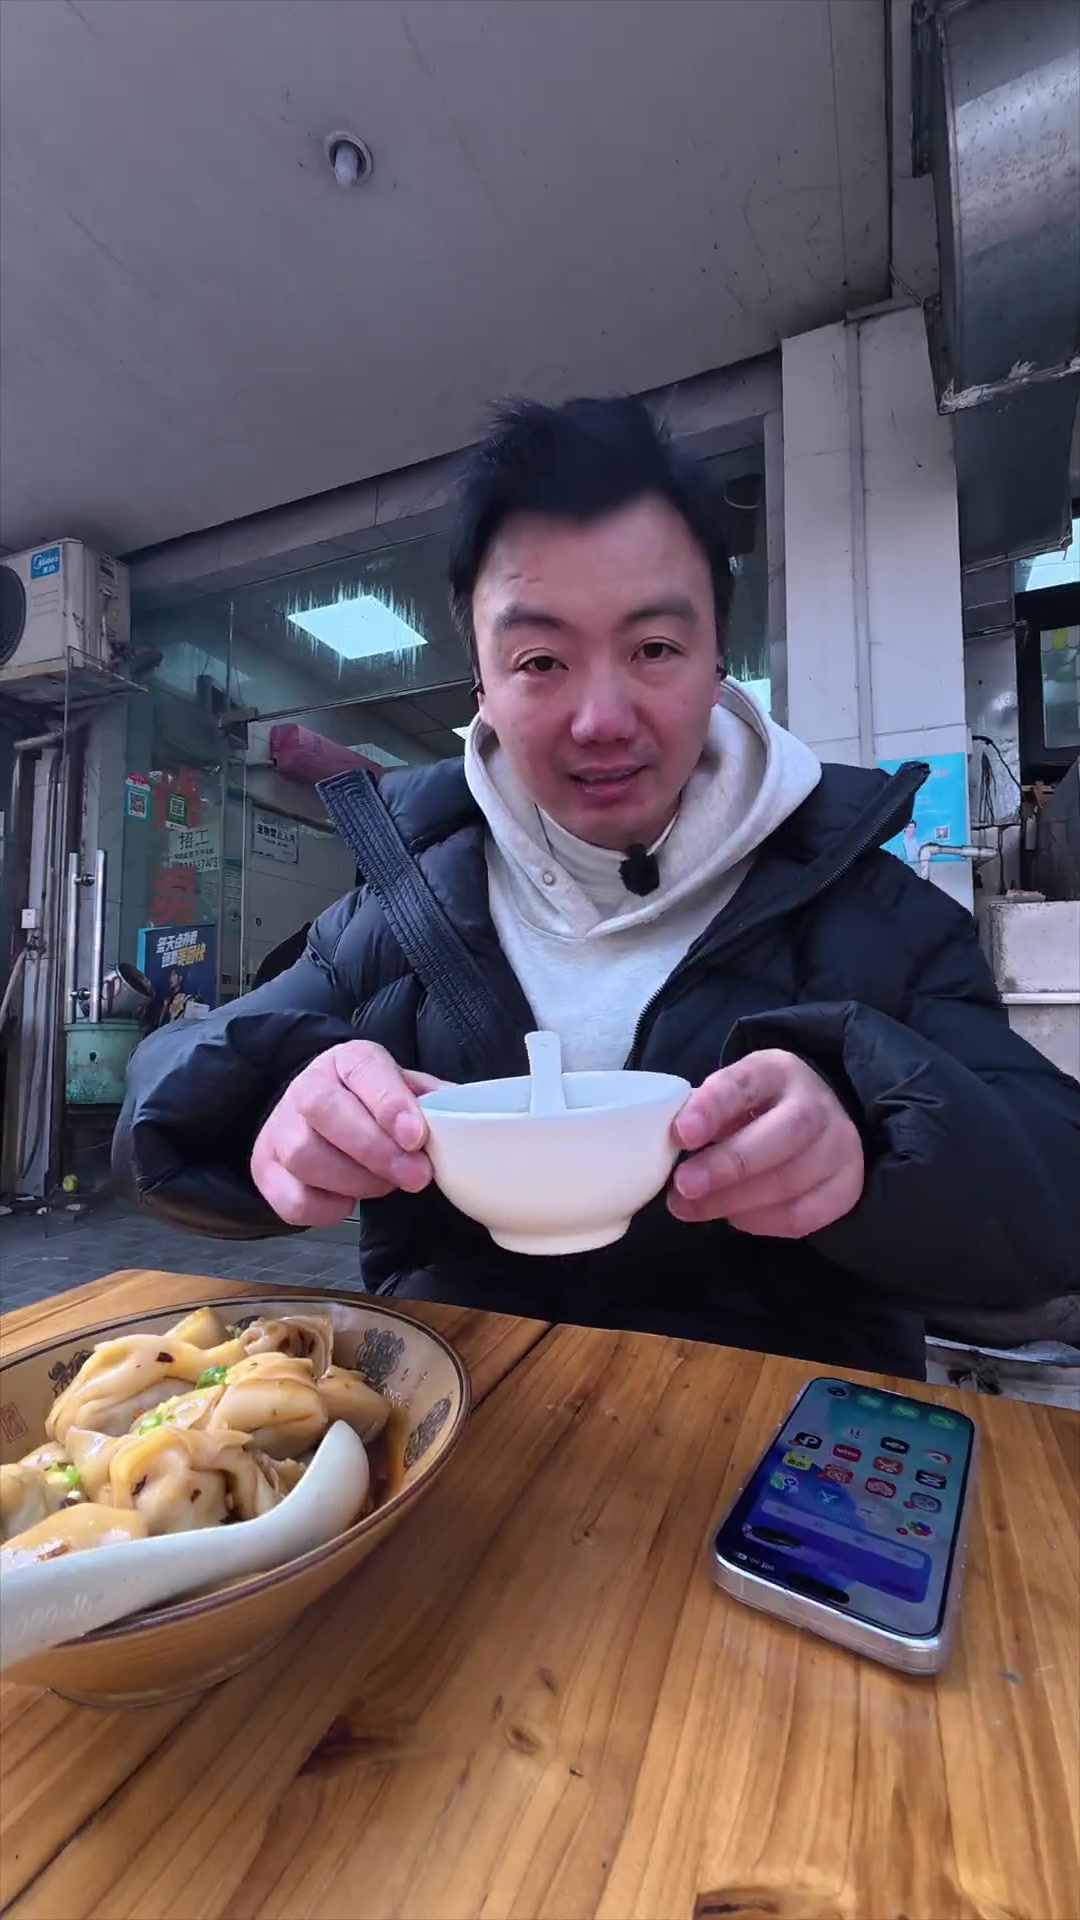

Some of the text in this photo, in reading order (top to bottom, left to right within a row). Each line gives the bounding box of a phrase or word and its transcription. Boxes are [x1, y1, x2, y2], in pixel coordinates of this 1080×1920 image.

[36, 554, 58, 568] Midea
[179, 829, 209, 850] 招工
[257, 823, 295, 845] 宠物禁止入内
